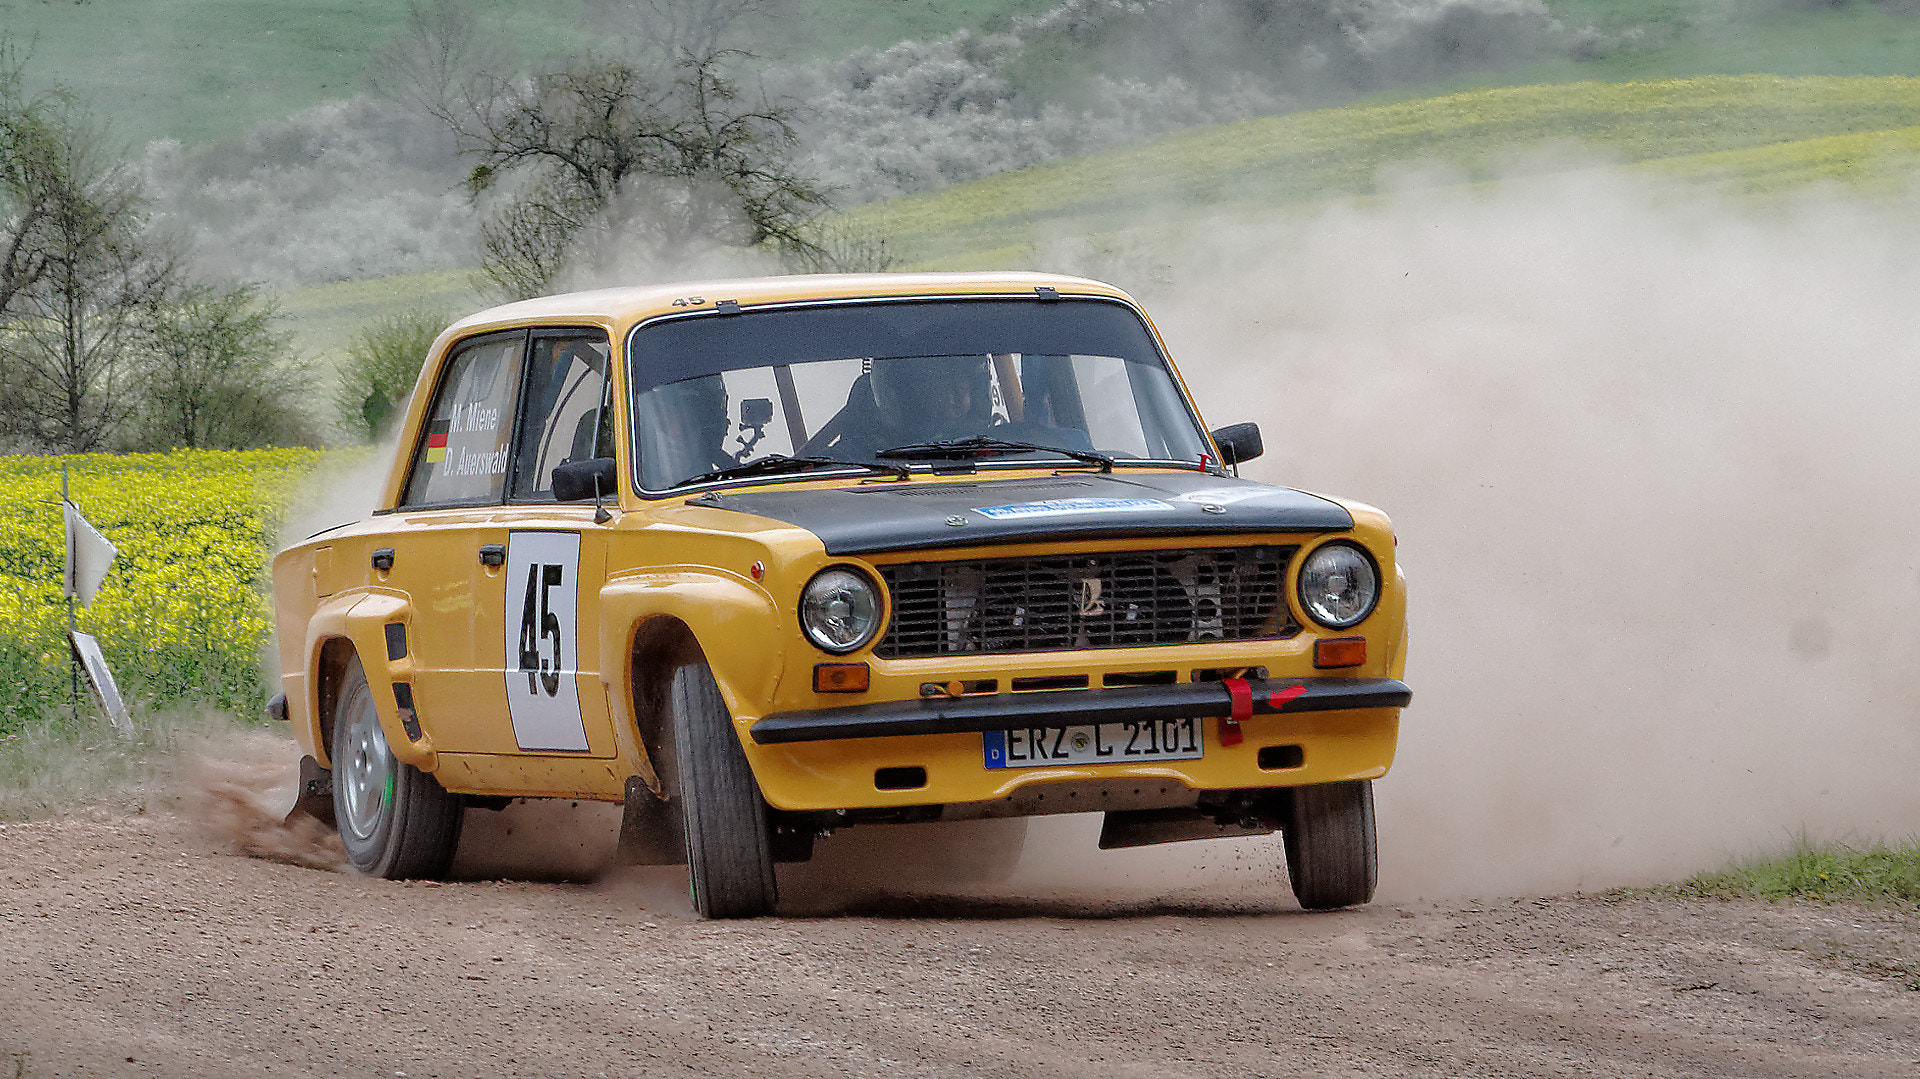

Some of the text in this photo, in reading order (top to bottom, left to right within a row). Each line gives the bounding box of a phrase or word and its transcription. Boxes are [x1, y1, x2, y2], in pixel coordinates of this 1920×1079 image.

[672, 296, 706, 307] 45
[450, 402, 498, 433] M. Miene
[443, 443, 511, 476] D. Auerswald
[519, 563, 563, 698] 45
[1008, 725, 1069, 761] ERZ
[1094, 723, 1113, 757] L
[1123, 717, 1199, 756] 2101
